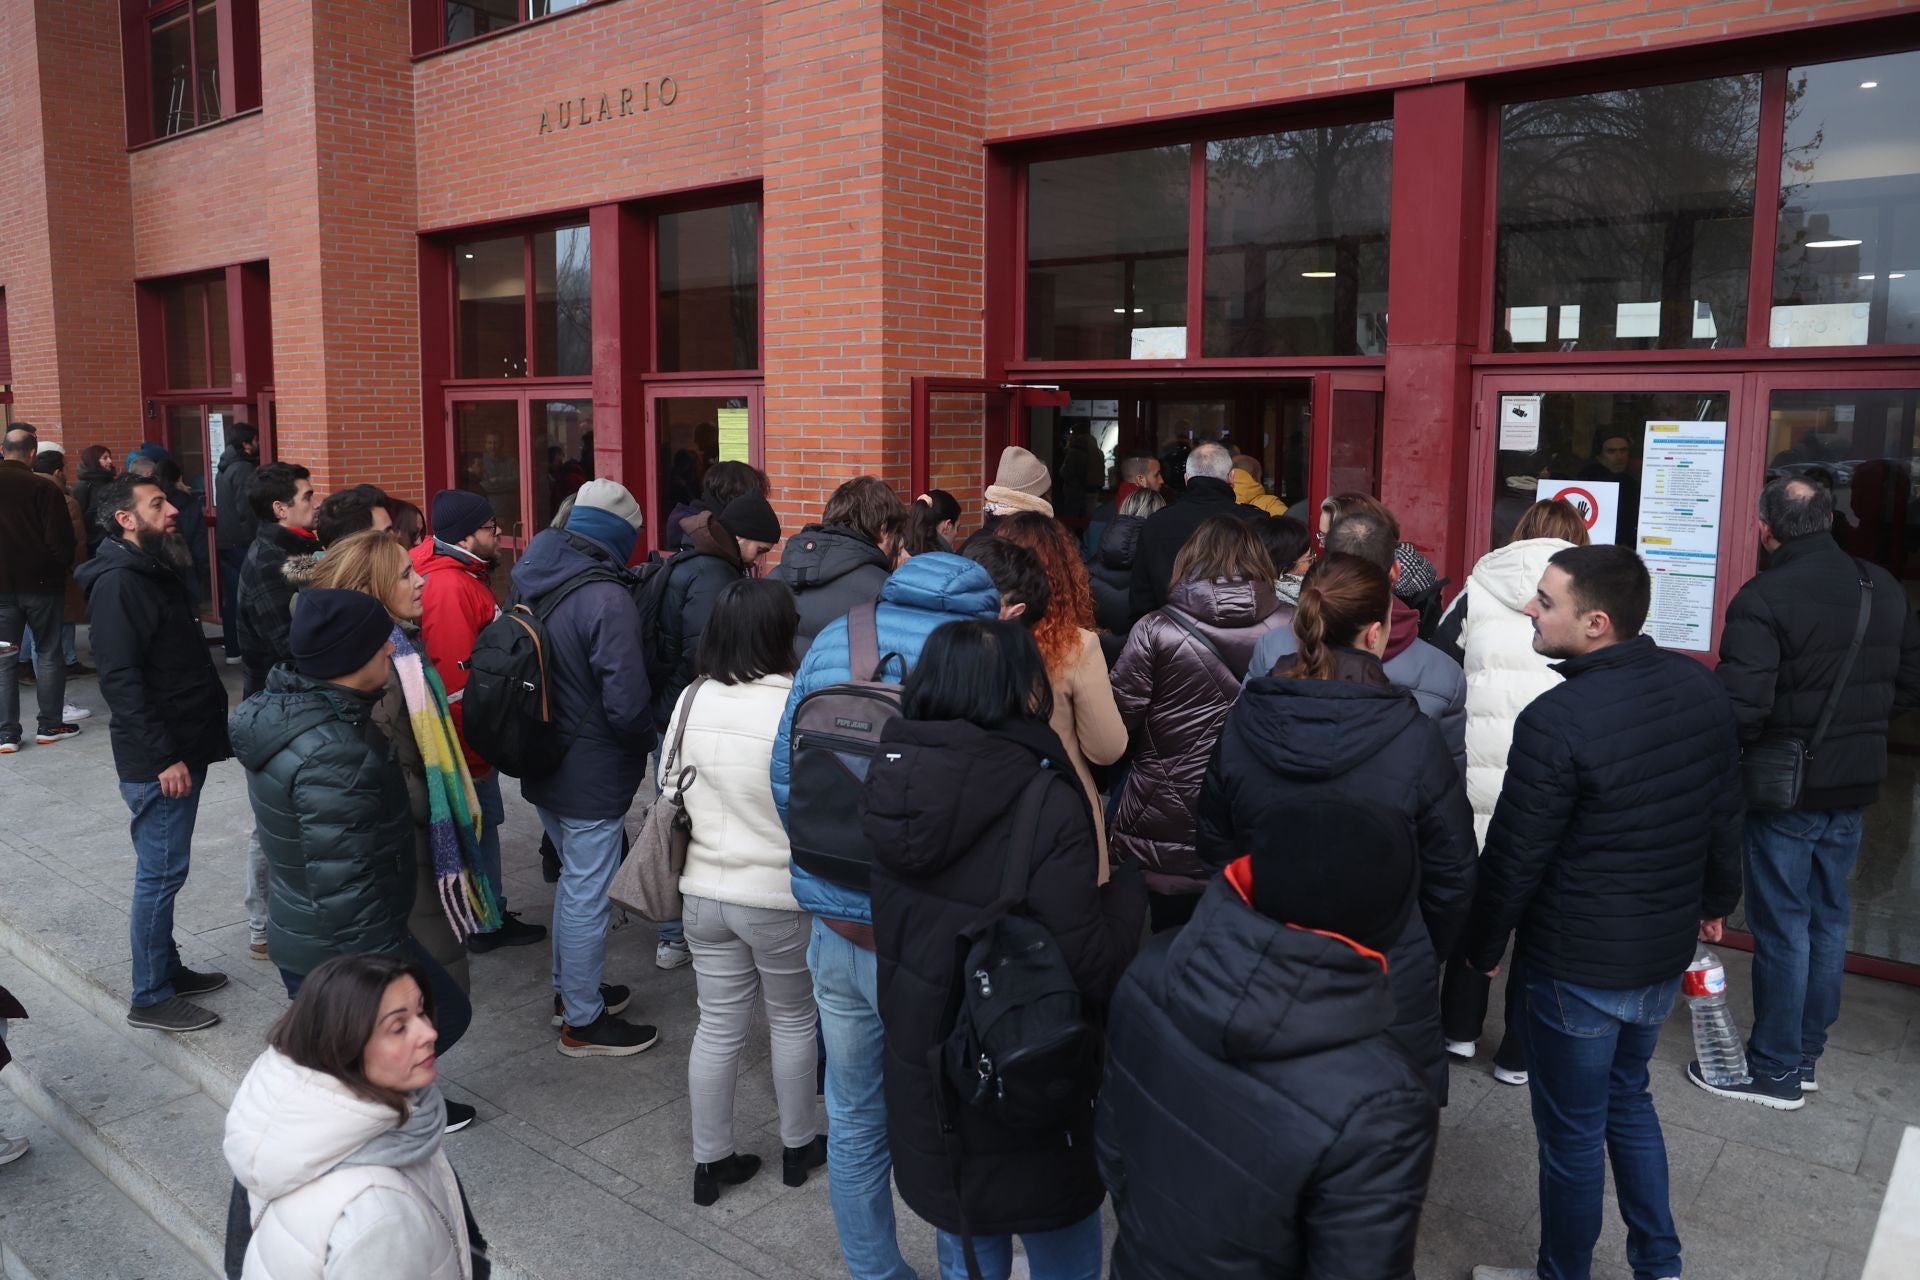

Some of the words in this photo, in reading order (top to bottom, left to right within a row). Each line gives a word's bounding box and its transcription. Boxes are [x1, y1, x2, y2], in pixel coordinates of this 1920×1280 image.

[539, 76, 677, 134] AULARIO
[836, 718, 850, 727] PEPE
[851, 721, 868, 730] JEANS
